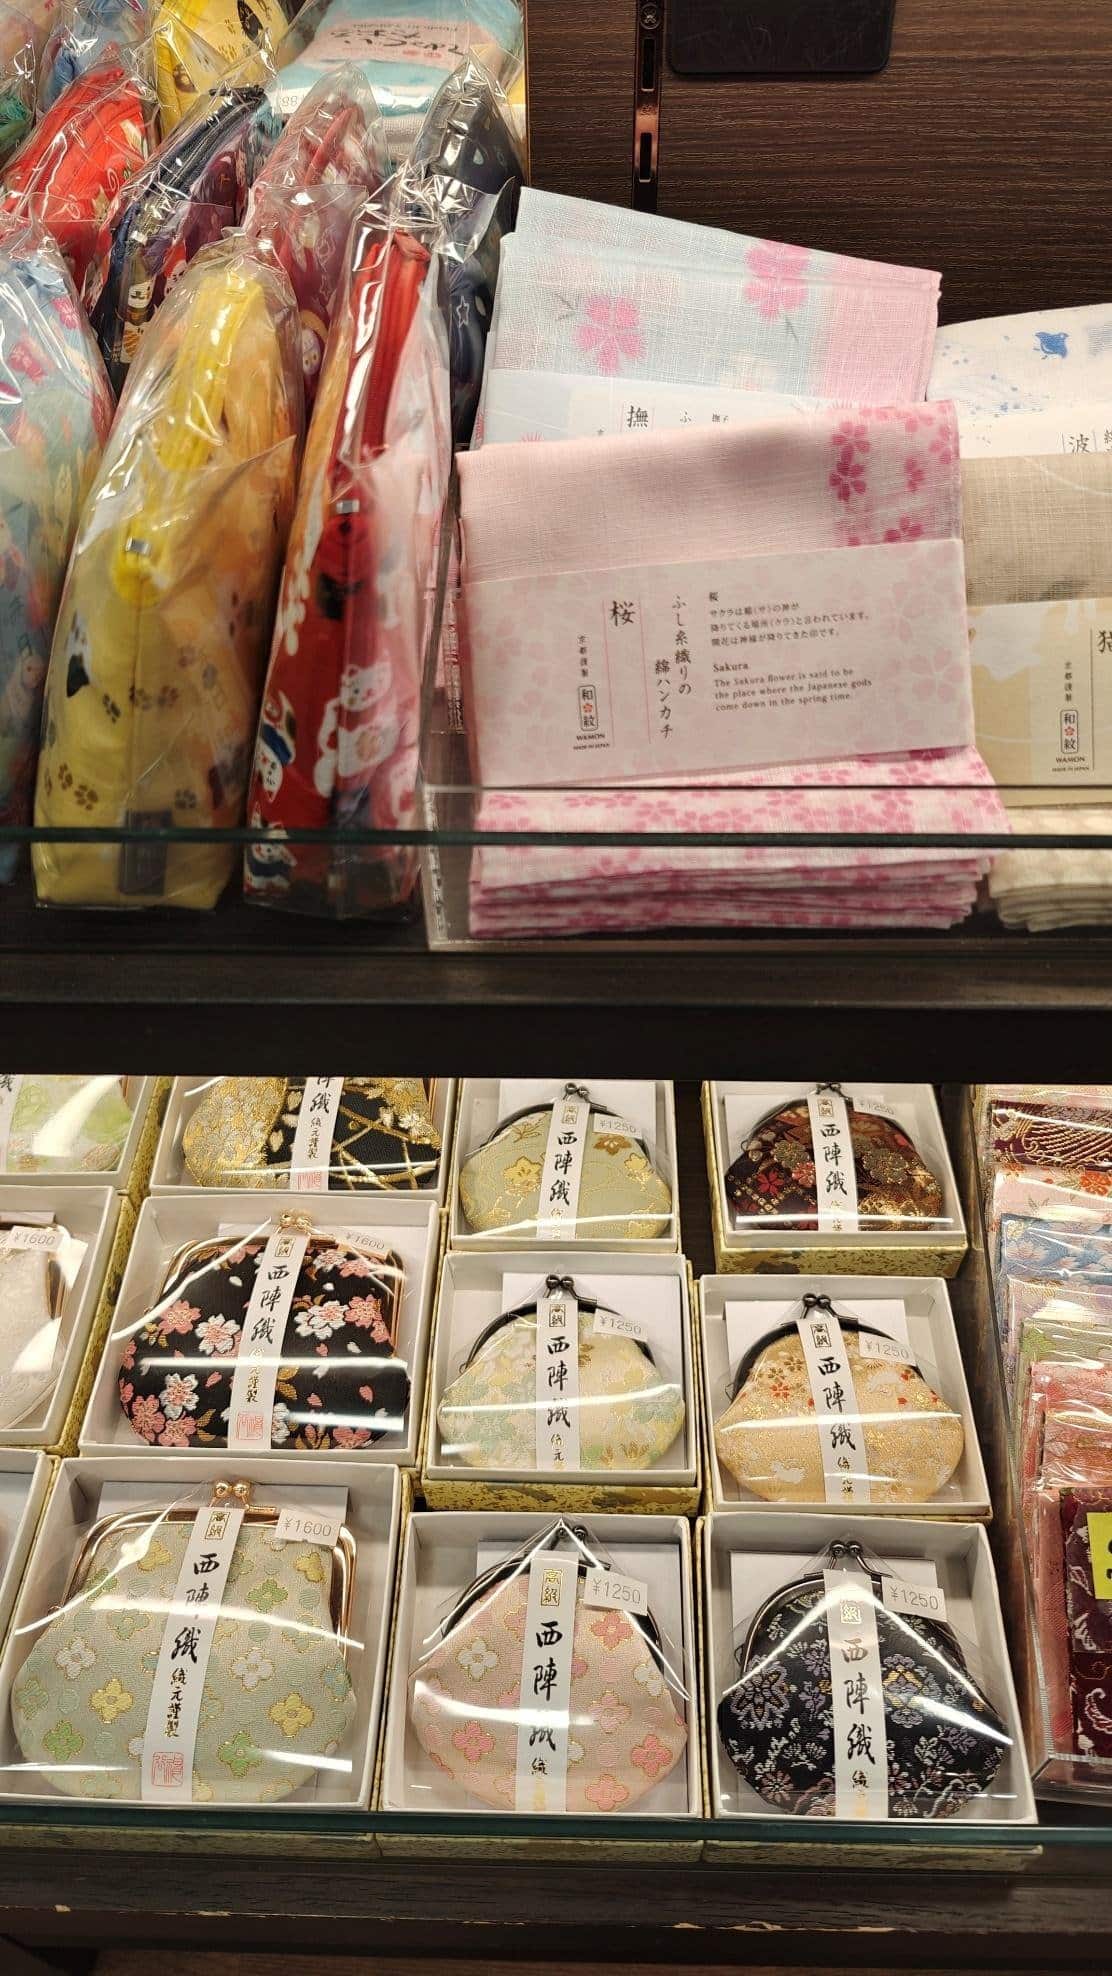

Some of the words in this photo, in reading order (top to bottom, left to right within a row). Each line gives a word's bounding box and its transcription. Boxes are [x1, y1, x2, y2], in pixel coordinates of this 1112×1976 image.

[627, 405, 649, 428] 撫
[1069, 433, 1090, 454] 波
[610, 600, 636, 627] 桜
[672, 595, 693, 696] ふし糸織りの
[713, 662, 749, 673] Sakura
[714, 678, 730, 688] The
[734, 676, 765, 686] Sakura
[767, 673, 795, 682] flower
[798, 672, 806, 680] is
[809, 670, 828, 679] said
[830, 669, 840, 677] to
[843, 668, 854, 676] be
[715, 690, 730, 700] the
[732, 688, 756, 700] place
[759, 685, 787, 695] where
[789, 684, 804, 693] the
[807, 681, 849, 692] Japanese
[851, 678, 873, 689] gods
[582, 688, 596, 728] 和紋
[715, 703, 739, 712] come
[742, 698, 767, 708] down
[769, 697, 778, 707] in
[780, 695, 795, 705] the
[798, 693, 828, 706] spring
[576, 733, 605, 741] WAMON
[1064, 712, 1076, 750] 和紋
[1055, 756, 1086, 764] WAMON
[599, 1119, 638, 1134] ¥1250
[550, 1131, 578, 1206] 西陣織
[820, 1123, 848, 1196] 西陣織
[13, 1231, 56, 1245] ¥1600
[251, 1265, 290, 1345] 西陣織
[599, 1315, 642, 1335] ¥1250
[866, 1340, 909, 1360] ¥1250
[546, 1335, 571, 1428] 西陣織
[817, 1356, 857, 1451] 西陣織
[283, 1516, 332, 1538] ¥1600
[592, 1578, 642, 1605] ¥1250
[889, 1586, 940, 1611] ¥1250
[171, 1552, 220, 1664] 西陣織
[529, 1620, 563, 1752] 西陣織
[841, 1639, 876, 1765] 西陣織
